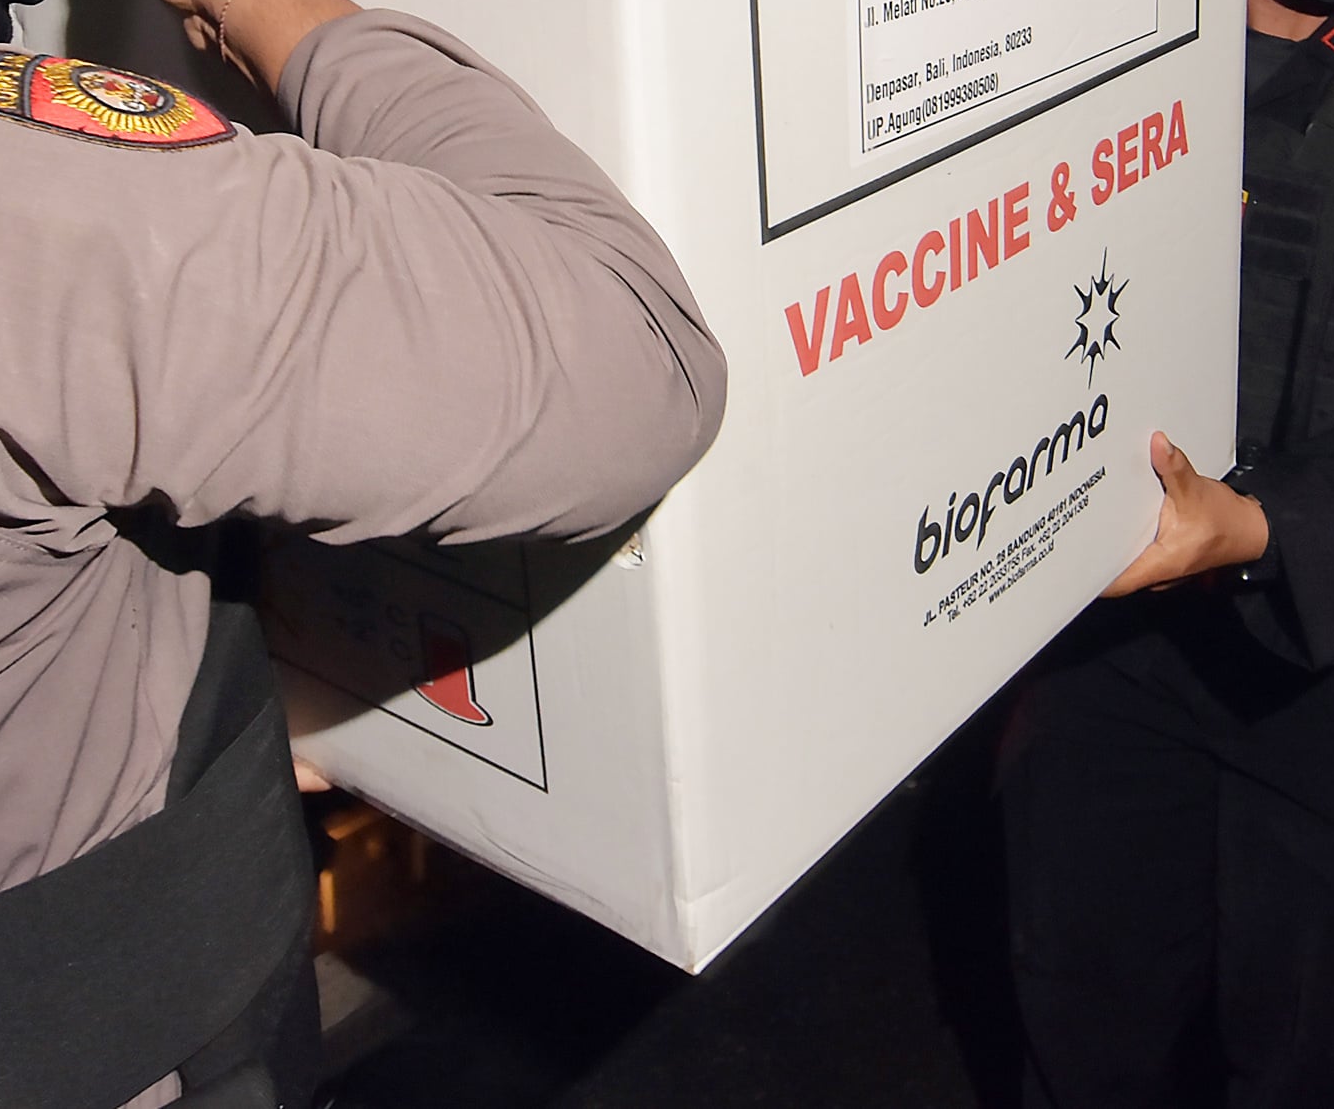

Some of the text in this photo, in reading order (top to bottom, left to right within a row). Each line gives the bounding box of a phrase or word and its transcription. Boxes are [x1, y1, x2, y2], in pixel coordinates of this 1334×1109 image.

[866, 26, 1033, 104] Denpasar, Bali, Indonesia, 80233
[784, 99, 1189, 377] VACCINE & SERA
[914, 393, 1109, 575] biofarma
[939, 572, 979, 614] PASTEUR
[1007, 516, 1046, 557] BANDUNG
[1069, 466, 1106, 506] INDONESIA
